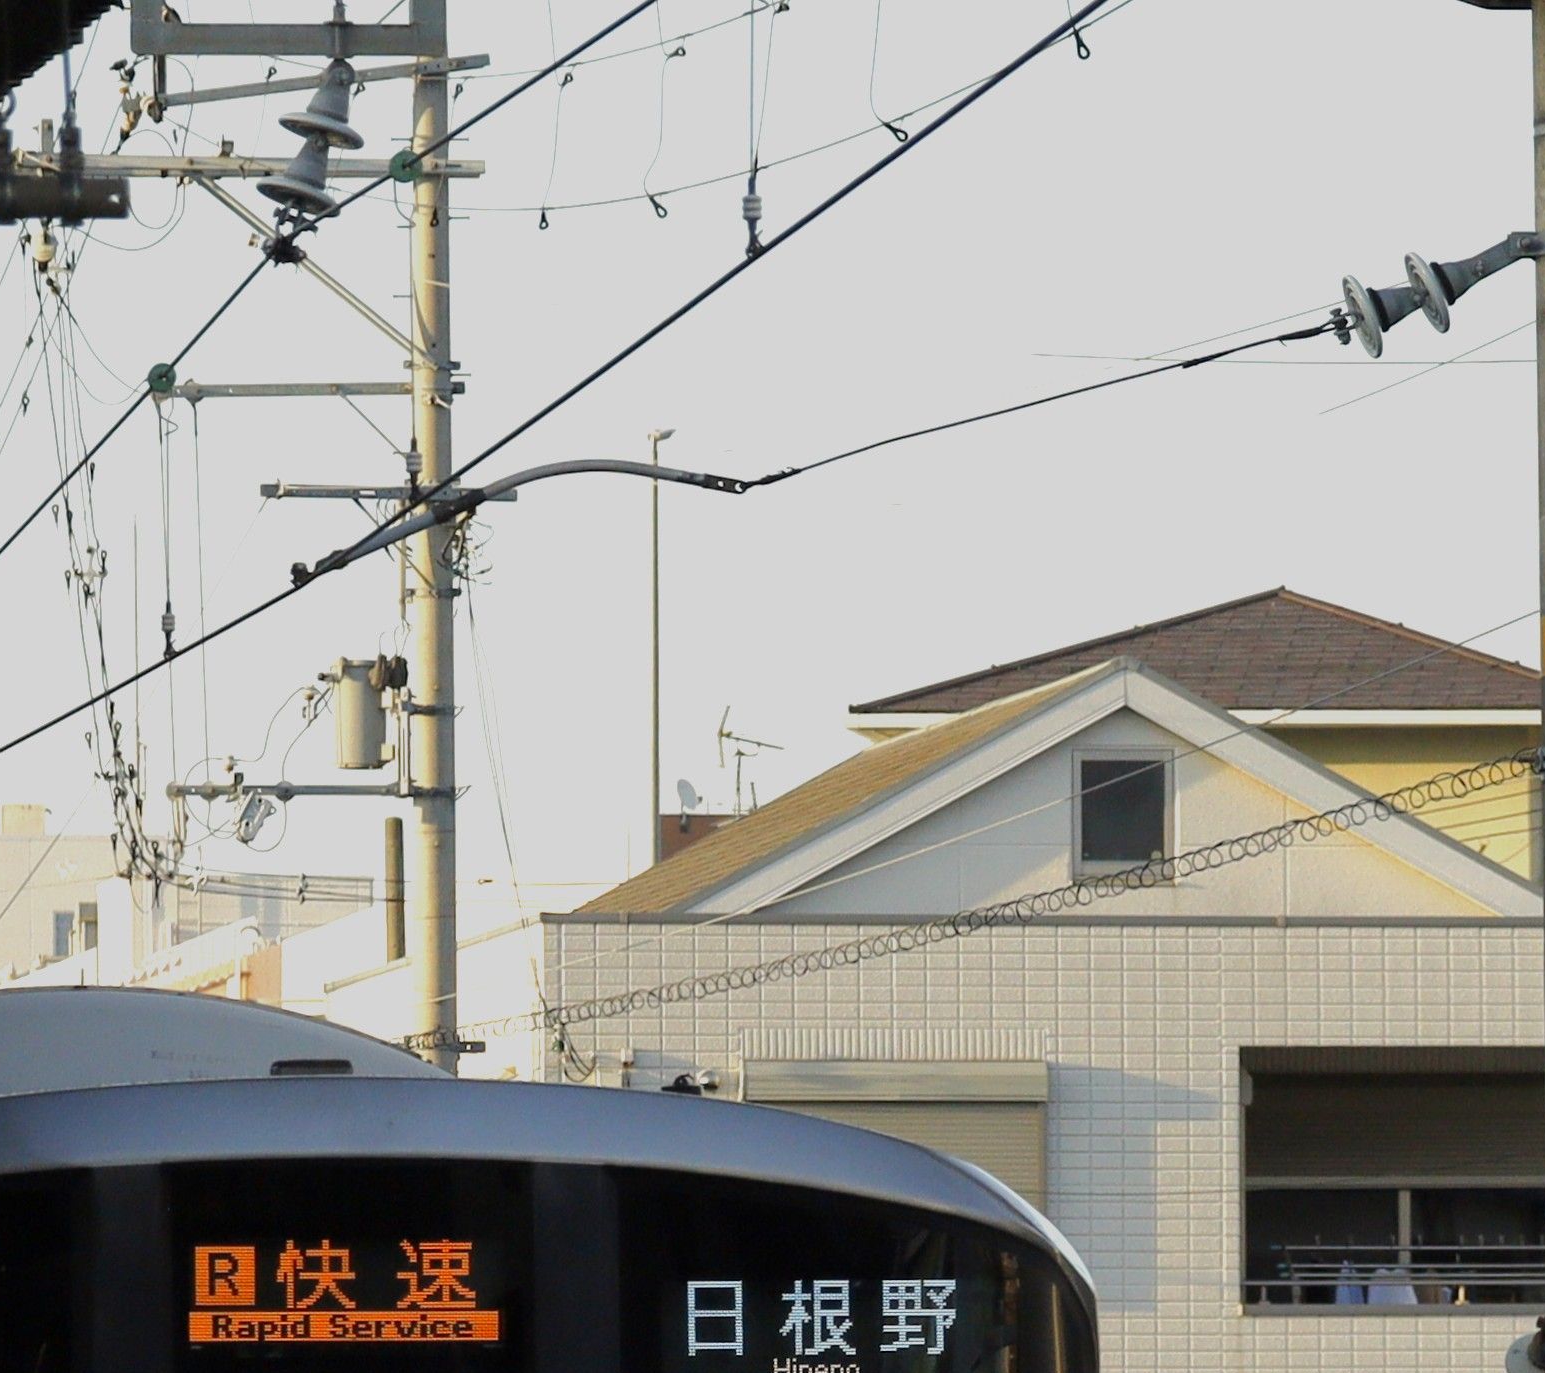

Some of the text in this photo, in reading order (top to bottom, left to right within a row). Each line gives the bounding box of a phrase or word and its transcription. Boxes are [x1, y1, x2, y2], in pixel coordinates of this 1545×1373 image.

[275, 1238, 479, 1310] 快速
[210, 1314, 475, 1344] Rapid Service
[686, 1278, 958, 1357] 日根野
